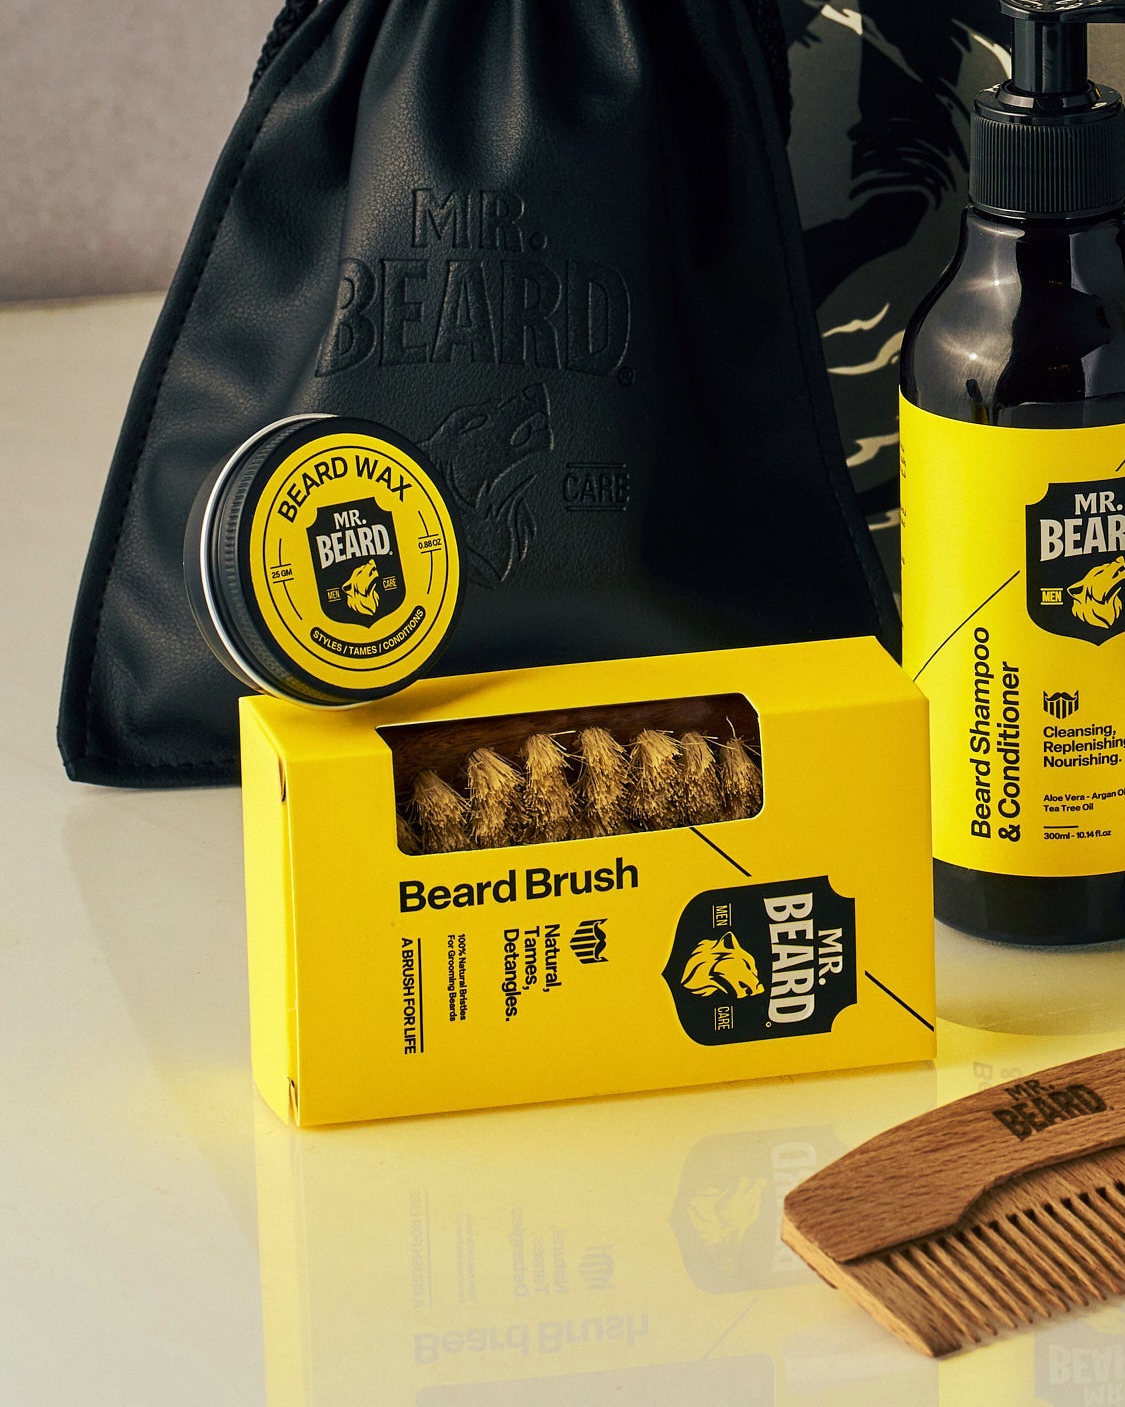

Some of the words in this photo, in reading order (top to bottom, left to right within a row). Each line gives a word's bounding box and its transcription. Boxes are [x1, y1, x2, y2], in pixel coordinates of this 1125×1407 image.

[412, 188, 548, 253] MR.
[278, 456, 348, 524] BEARD
[355, 455, 413, 503] WAX
[564, 473, 631, 505] CARE
[1074, 491, 1123, 515] MR.
[333, 509, 367, 531] MR.
[418, 539, 433, 549] 0.88
[433, 538, 442, 547] OZ
[271, 571, 281, 579] 25
[281, 569, 293, 578] GM
[327, 589, 340, 600] MEN
[382, 578, 397, 589] CARE
[1042, 590, 1062, 603] MEN
[312, 630, 342, 652] STYLES
[349, 645, 378, 656] TAMES
[383, 608, 424, 651] CONDITIONS
[970, 627, 994, 754] Shampoo
[997, 661, 1020, 819] Conditioner
[1043, 724, 1116, 738] Cleansing,
[1043, 753, 1122, 767] Nourishing.
[970, 758, 991, 839] Beard
[1043, 794, 1063, 802] Aloe
[1091, 791, 1116, 800] Argan
[1082, 803, 1094, 811] Oil
[998, 824, 1020, 842] &
[1043, 832, 1070, 840] 300ml
[1076, 831, 1094, 839] 10.14
[399, 870, 516, 913] Beard
[526, 857, 638, 900] Brush
[715, 905, 728, 927] MEN
[401, 938, 413, 948] A
[458, 934, 466, 956] 100%
[817, 927, 843, 986] MR.
[447, 950, 456, 991] Grooming
[523, 926, 540, 990] Tames,
[542, 924, 562, 993] Natural,
[402, 950, 414, 996] BRUSH
[459, 957, 467, 988] Natural
[501, 929, 522, 1022] Detangles.
[403, 998, 416, 1026] FOR
[449, 992, 457, 1022] Beards
[460, 989, 468, 1020] Bristles
[717, 1006, 730, 1031] CARE
[404, 1027, 416, 1055] LIFE
[1004, 1079, 1055, 1101] MR.
